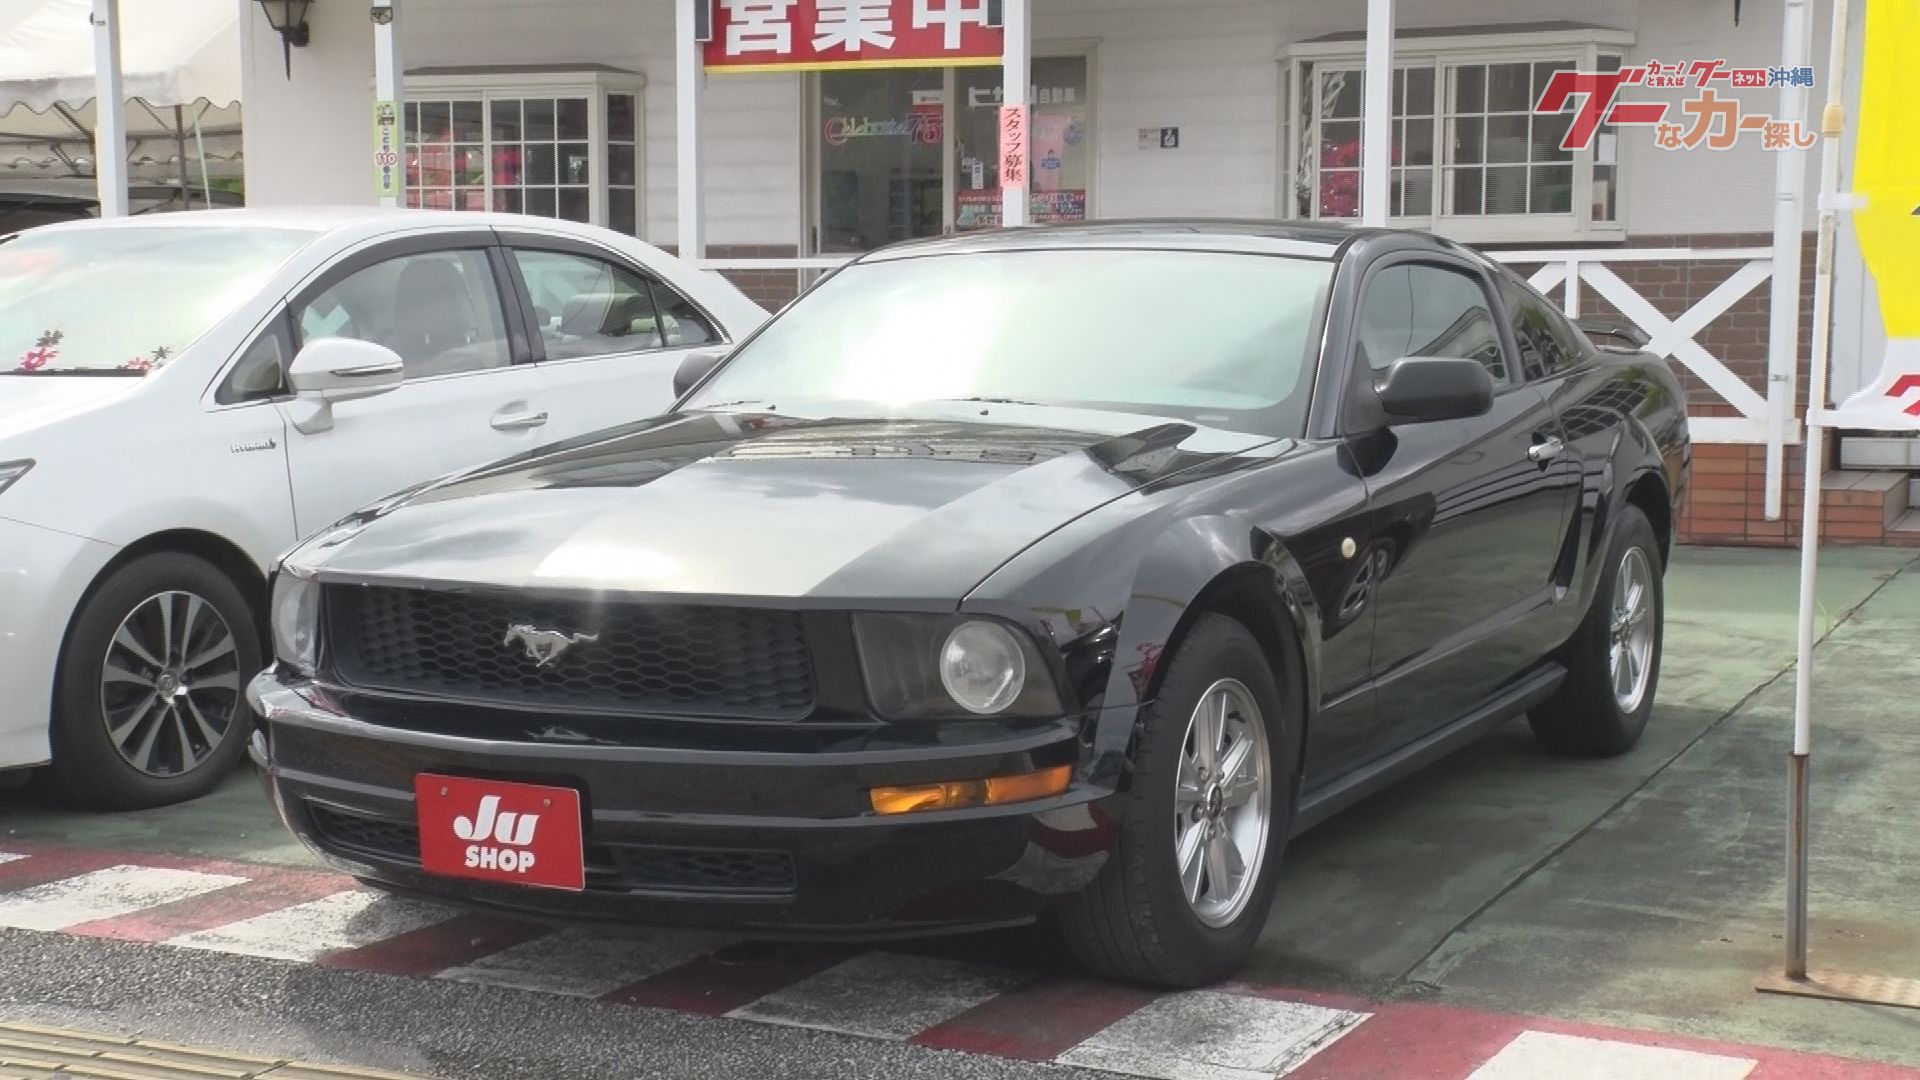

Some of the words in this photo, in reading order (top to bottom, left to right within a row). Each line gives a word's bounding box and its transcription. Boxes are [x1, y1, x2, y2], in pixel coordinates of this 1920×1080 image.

[717, 0, 987, 55] 営業中
[1004, 108, 1022, 182] スタッフ募集
[464, 845, 535, 873] SHOP
